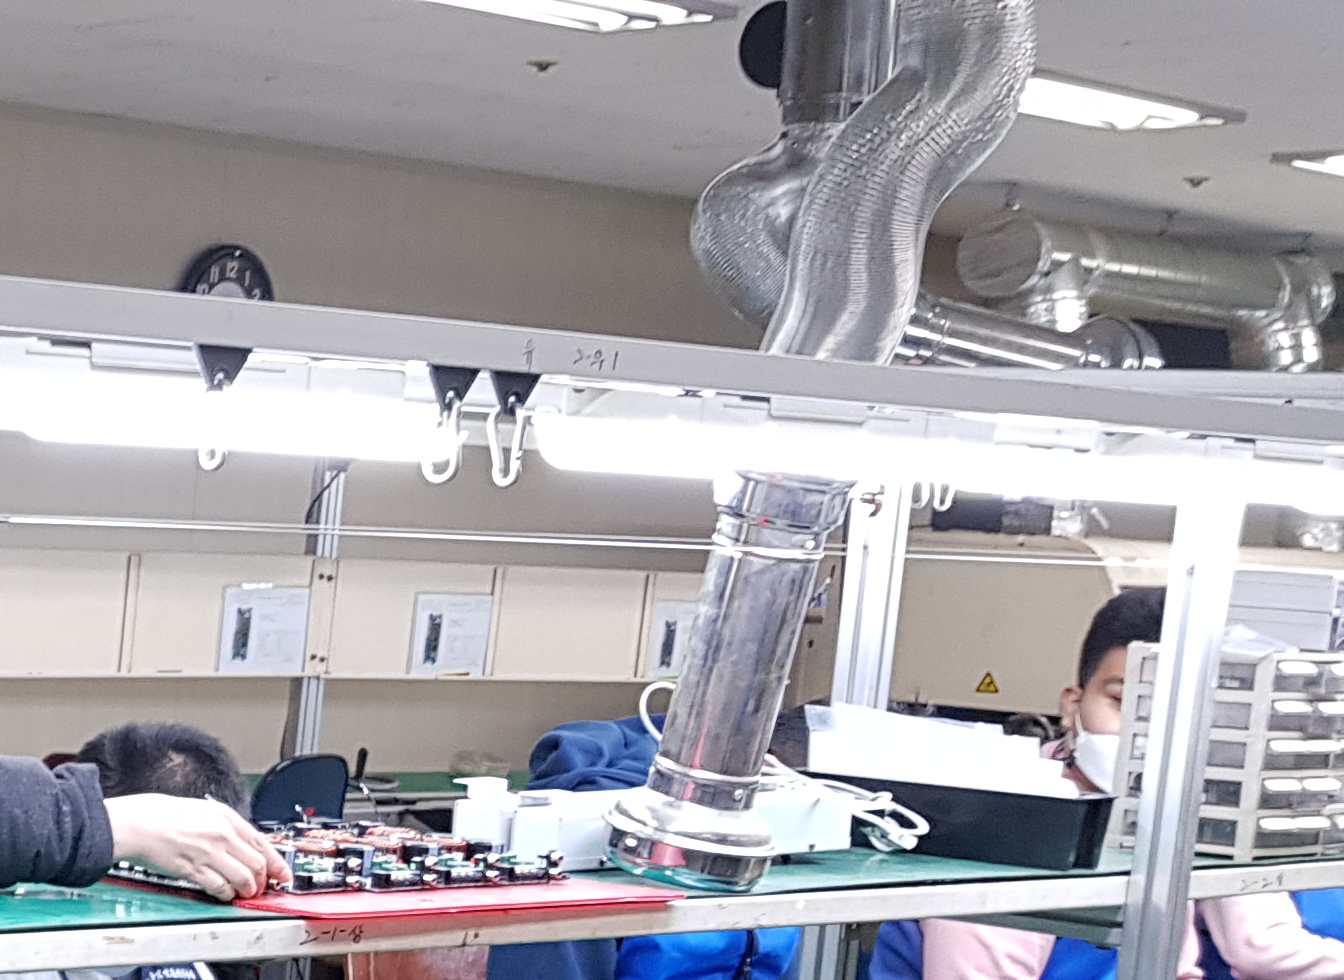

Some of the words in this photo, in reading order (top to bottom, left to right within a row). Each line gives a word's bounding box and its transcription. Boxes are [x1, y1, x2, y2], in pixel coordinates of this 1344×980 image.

[209, 264, 220, 284] 11
[226, 260, 239, 280] 12
[244, 269, 251, 288] 1
